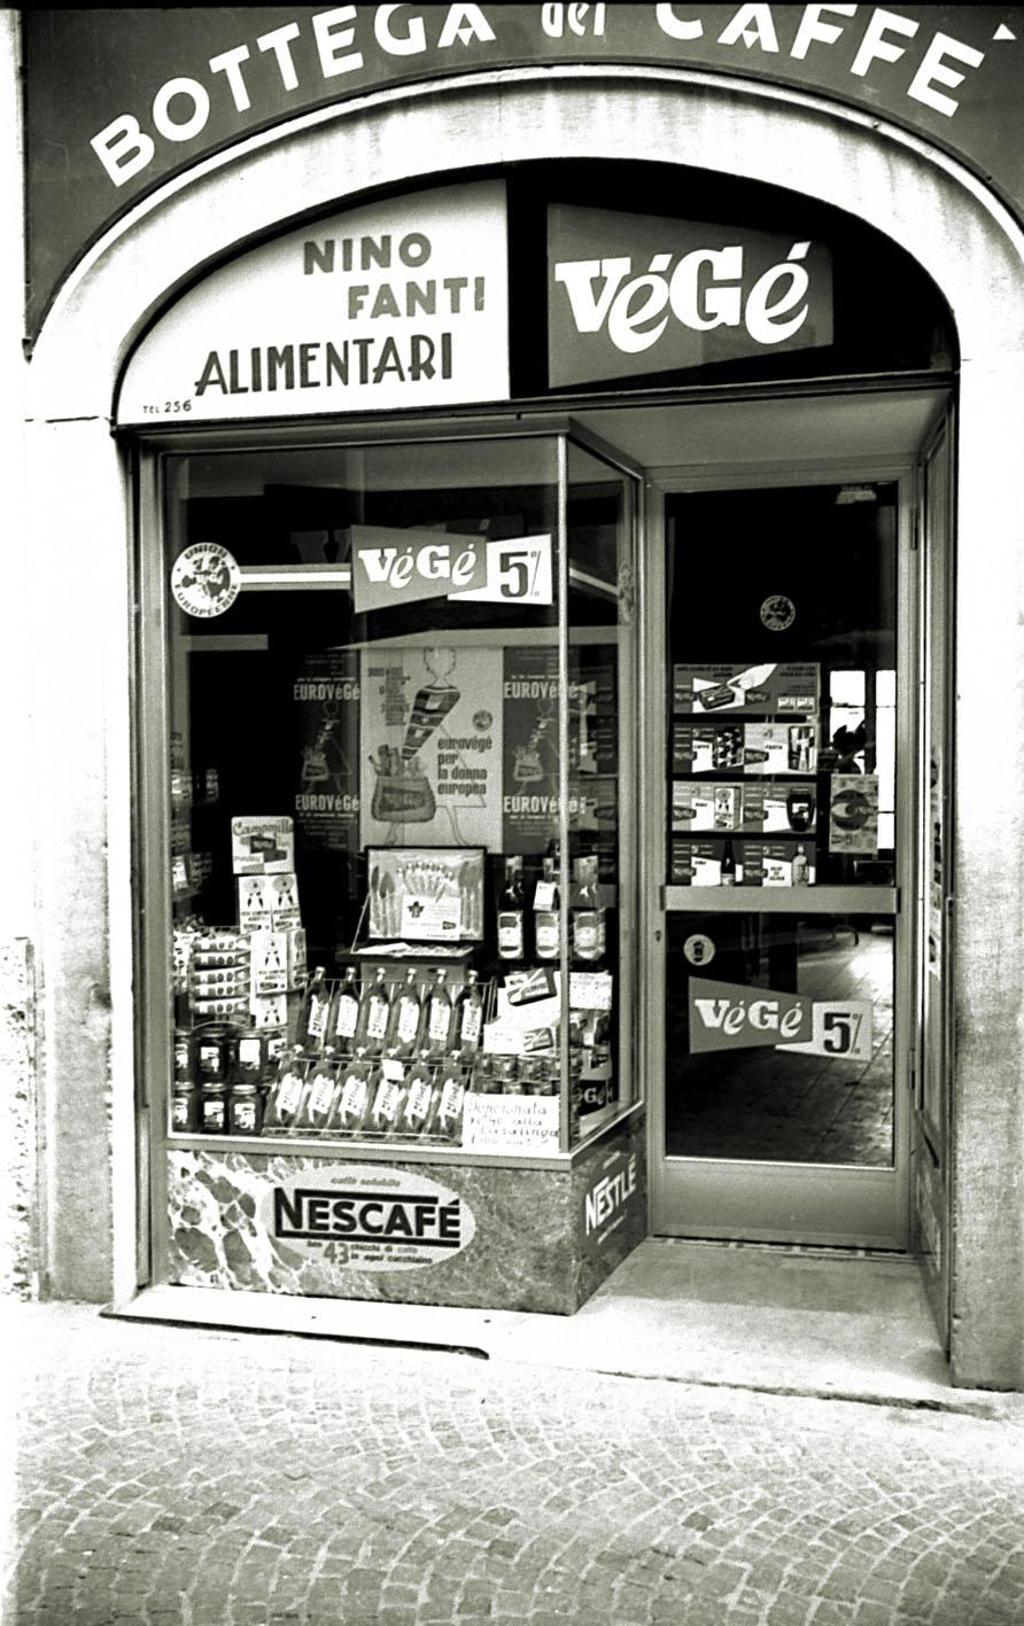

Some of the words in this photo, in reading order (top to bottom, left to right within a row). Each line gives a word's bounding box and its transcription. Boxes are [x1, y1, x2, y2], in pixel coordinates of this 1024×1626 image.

[90, 4, 496, 187] BOTTEGA
[304, 232, 432, 275] NINO
[348, 276, 485, 320] FANTI
[555, 241, 811, 353] VéGé
[194, 332, 452, 396] ALIMENTARI
[164, 399, 192, 413] 256
[358, 543, 477, 589] VéGé
[437, 753, 459, 766] per
[437, 767, 448, 781] la
[451, 767, 488, 781] donna
[437, 782, 487, 797] europea
[695, 999, 803, 1037] VéGé
[586, 1153, 636, 1236] NESTLÉ
[274, 1187, 460, 1248] NESCAFÉ
[323, 1242, 350, 1265] 43
